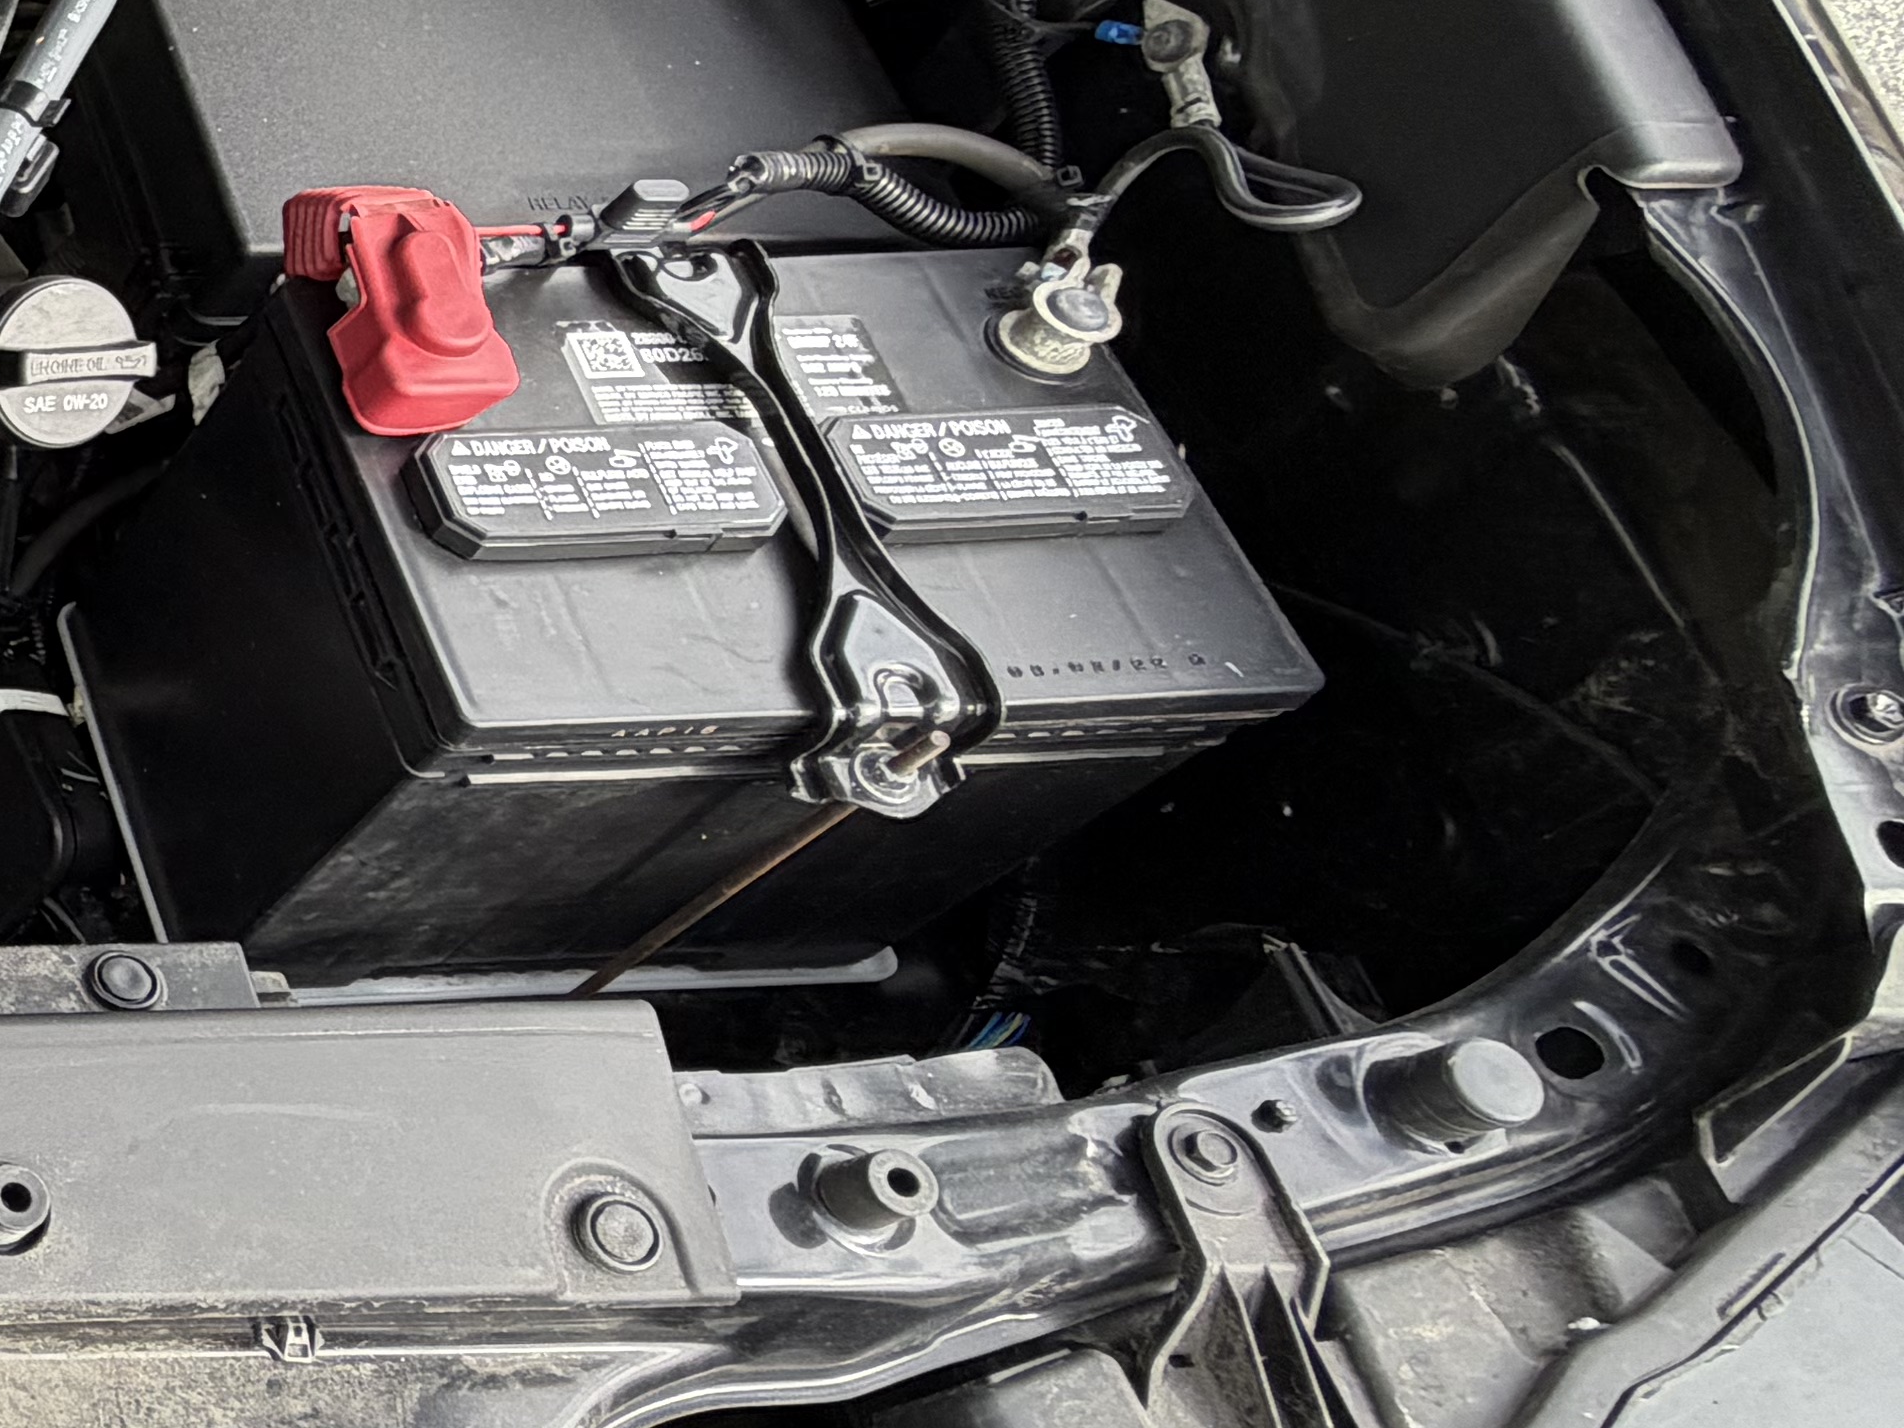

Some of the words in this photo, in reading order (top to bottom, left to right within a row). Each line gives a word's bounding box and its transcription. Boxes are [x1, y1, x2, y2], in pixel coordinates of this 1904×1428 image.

[30, 357, 84, 376] ENGINE
[85, 357, 108, 374] OIL
[23, 395, 57, 414] SAE
[63, 392, 109, 412] 0W-20
[869, 422, 937, 440] DANGER
[947, 418, 1012, 437] POISON
[470, 439, 536, 457] DANGER
[549, 436, 611, 454] POISON
